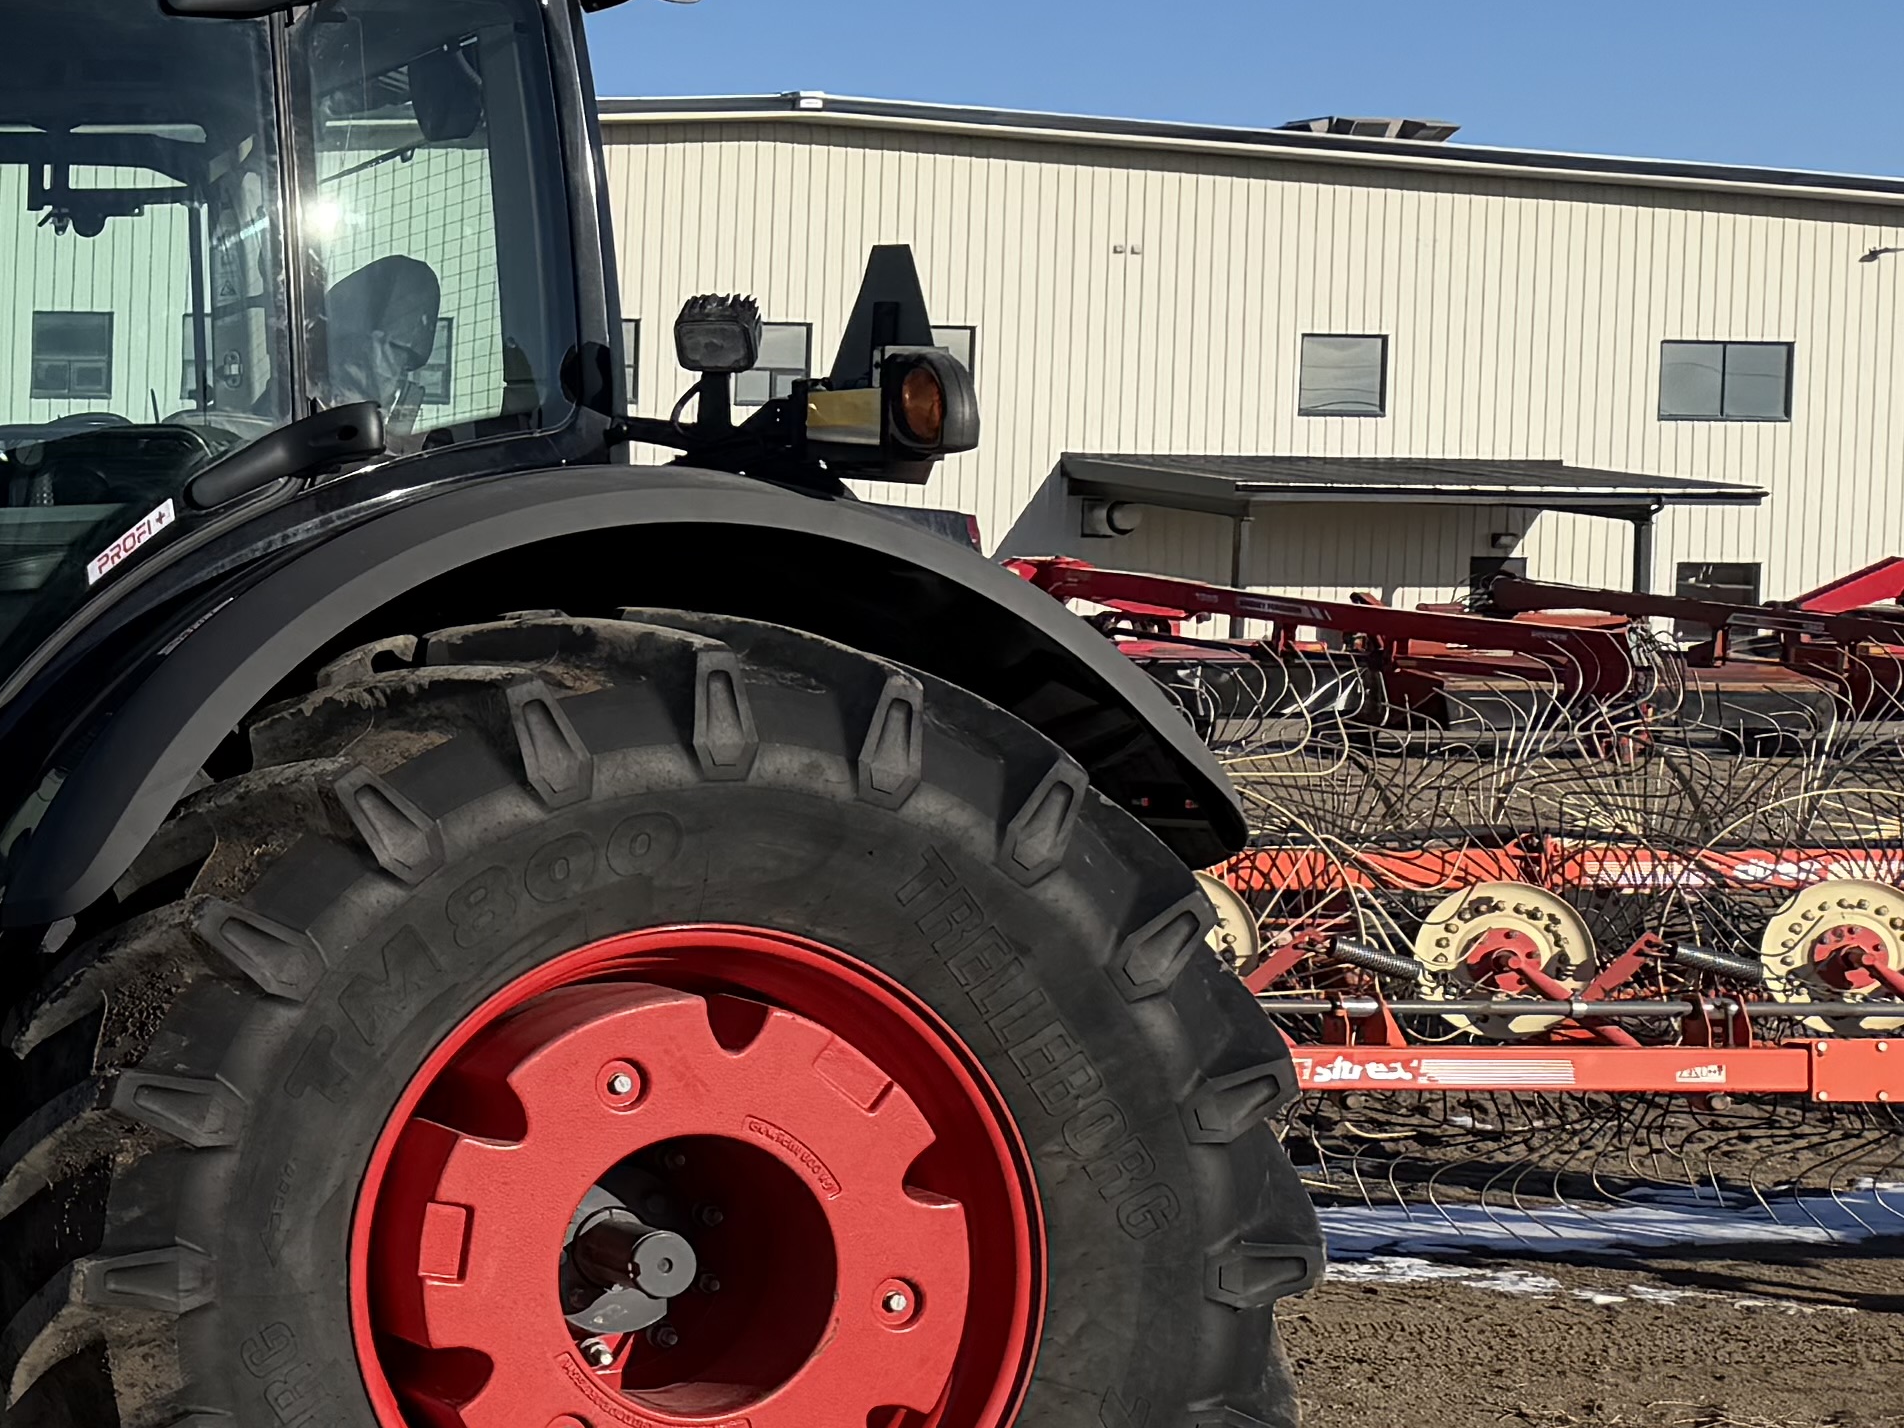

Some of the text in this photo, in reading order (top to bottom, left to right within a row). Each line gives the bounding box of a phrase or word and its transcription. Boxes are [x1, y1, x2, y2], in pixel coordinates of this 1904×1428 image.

[97, 519, 152, 575] PROFI
[285, 810, 684, 1105] TM800
[895, 844, 1181, 1241] TRELLEBORG
